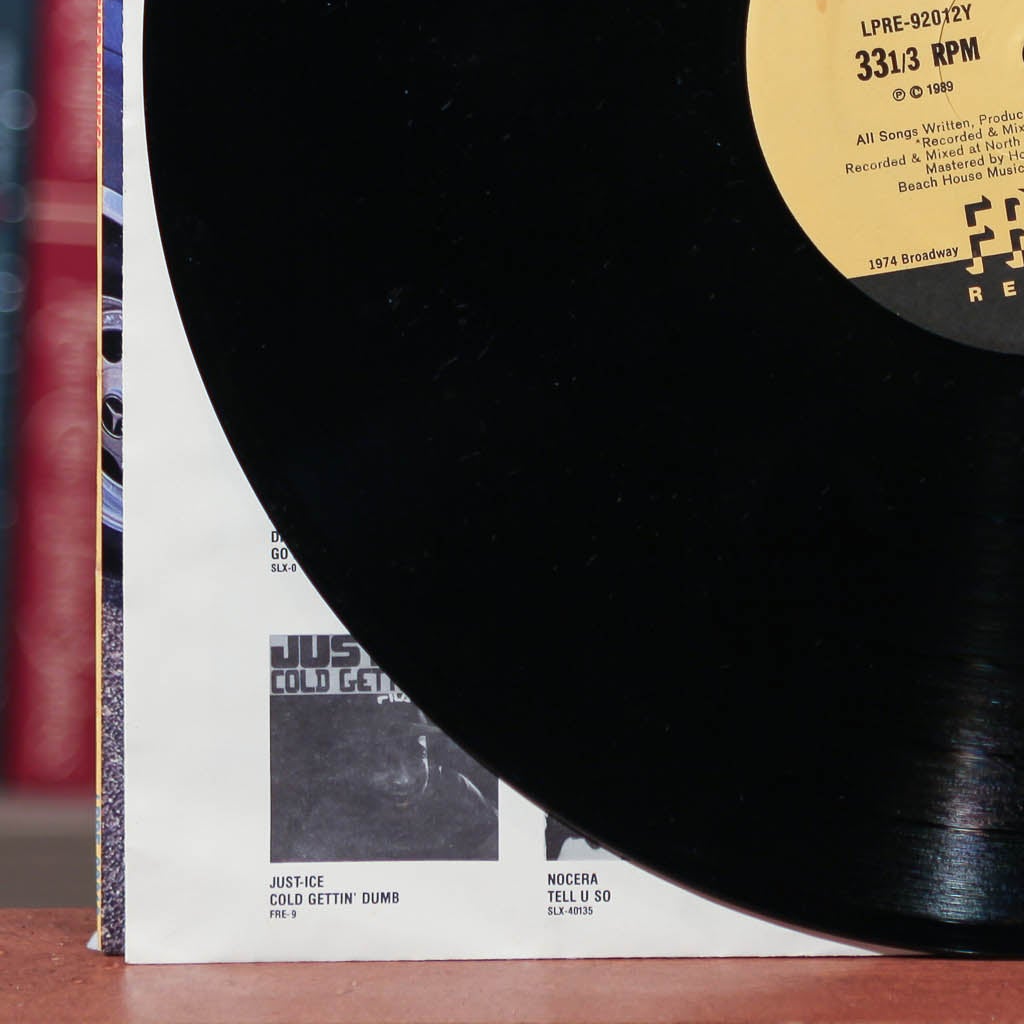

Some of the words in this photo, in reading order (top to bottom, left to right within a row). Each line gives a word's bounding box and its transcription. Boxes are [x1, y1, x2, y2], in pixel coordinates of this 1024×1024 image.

[860, 2, 971, 37] LPRE-92012Y
[930, 35, 980, 67] RPM
[925, 80, 953, 95] 1989
[856, 131, 874, 146] All
[878, 128, 918, 142] Songs
[921, 119, 974, 139] Written,
[987, 126, 998, 137] &
[845, 153, 906, 174] Recorded
[911, 152, 921, 163] &
[925, 143, 964, 161] Mixed
[968, 141, 981, 154] at
[984, 135, 1020, 151] North
[925, 154, 984, 174] Mastered
[988, 152, 1003, 165] by
[897, 176, 938, 192] Beach
[941, 167, 983, 185] House
[868, 255, 897, 270] 1974
[900, 246, 958, 264] Broadway
[271, 635, 377, 668] JUS
[271, 669, 330, 694] COLD
[269, 875, 325, 889] JUST-ICE
[547, 873, 599, 886] NOCERA
[269, 893, 303, 906] COLD
[362, 891, 400, 904] DUMB
[547, 890, 577, 903] TELL
[580, 890, 589, 903] U
[594, 889, 612, 903] SO
[547, 906, 594, 916] SLX-40135
